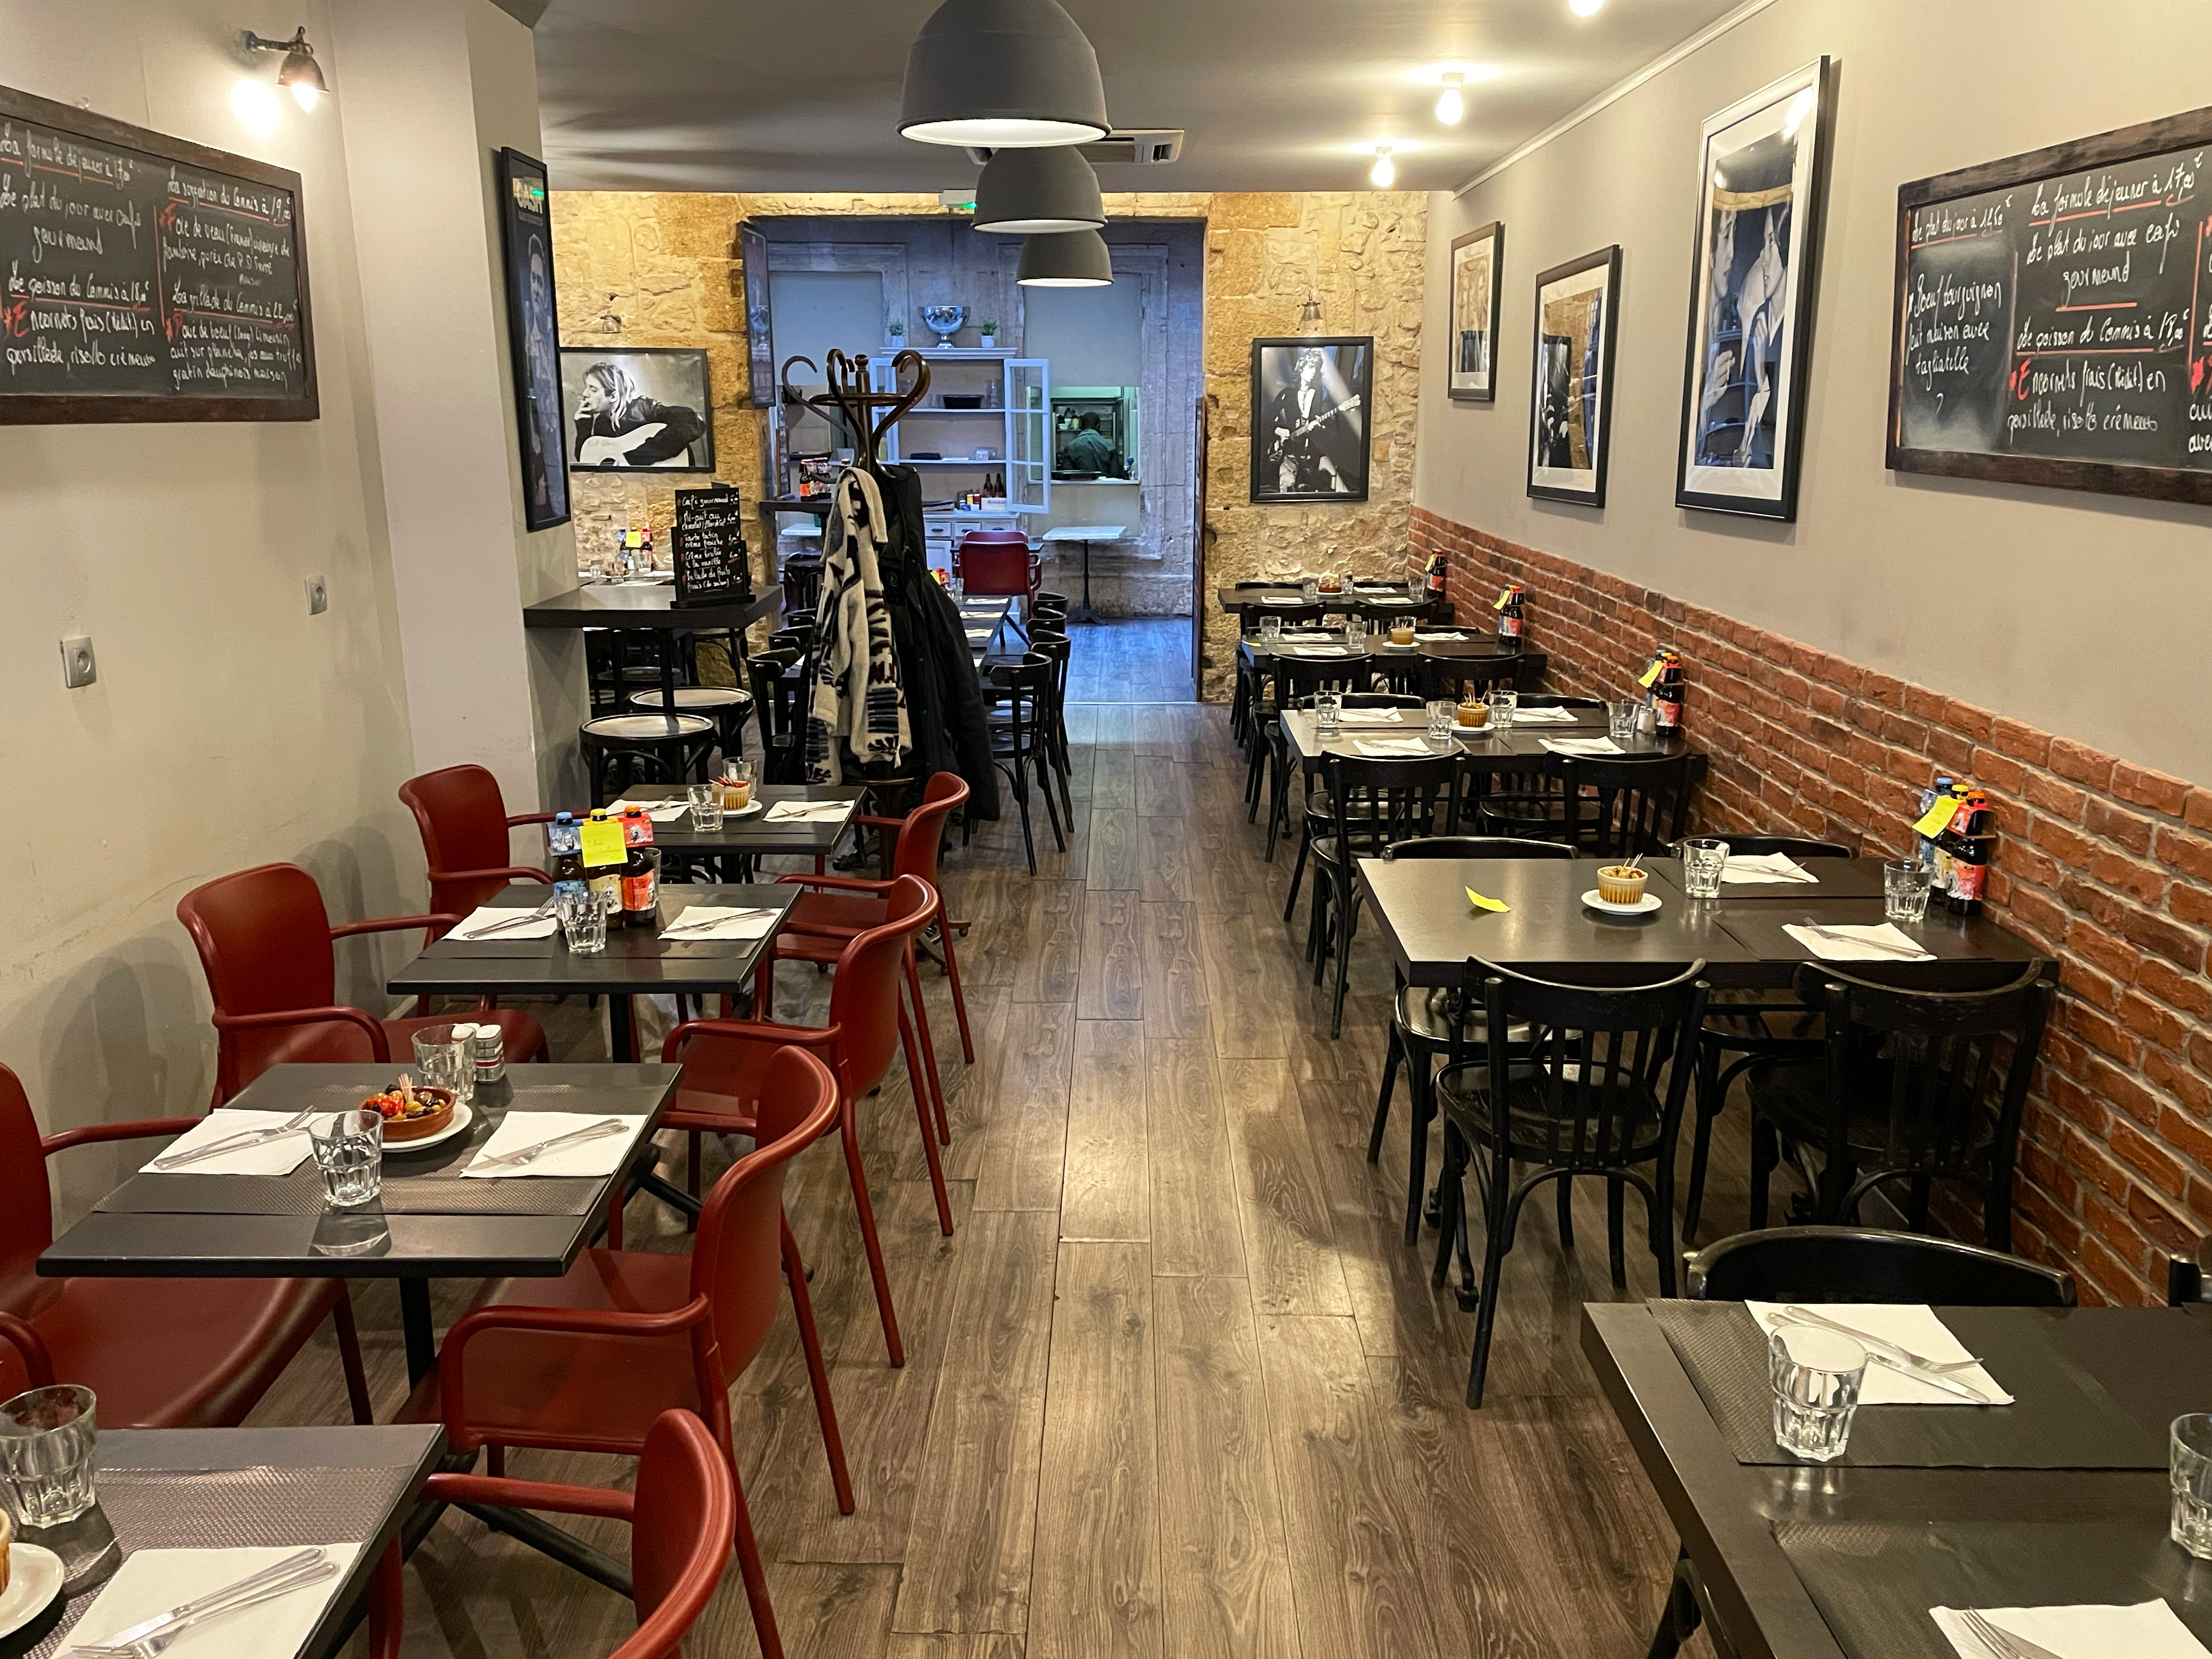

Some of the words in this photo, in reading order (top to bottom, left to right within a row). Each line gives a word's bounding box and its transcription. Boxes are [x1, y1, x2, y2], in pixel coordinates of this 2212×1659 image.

[24, 129, 63, 178] formule
[21, 181, 45, 213] plat
[49, 184, 63, 210] du
[65, 195, 89, 220] jour
[93, 207, 113, 222] avec
[220, 184, 230, 205] du
[261, 198, 269, 214] à
[2031, 183, 2049, 216] La
[2048, 176, 2093, 238] formule
[2096, 175, 2149, 220] déjeuner
[2152, 174, 2161, 194] à
[32, 226, 103, 264] gourmand
[193, 215, 202, 238] de
[280, 238, 290, 257] de
[1925, 210, 1940, 248] plat
[1942, 208, 1952, 233] du
[1952, 212, 1969, 243] jour
[1970, 208, 1977, 229] à
[2026, 232, 2042, 265] Le
[2047, 226, 2070, 264] plat
[2073, 228, 2087, 254] du
[2088, 229, 2110, 252] jour
[2114, 228, 2137, 248] avec
[2146, 212, 2180, 275] café
[8, 259, 25, 293] Le
[28, 276, 66, 302] poisson
[69, 274, 81, 297] du
[87, 273, 119, 300] Commis
[172, 278, 187, 304] La
[189, 284, 221, 313] grillade
[223, 290, 233, 311] du
[2062, 250, 2130, 309] gourmand
[1914, 273, 1944, 329] Boeuf
[1943, 274, 2001, 321] bourguignon
[80, 307, 105, 343] frais
[140, 319, 155, 336] en
[199, 319, 208, 338] de
[1927, 322, 1959, 343] maison
[1963, 321, 1990, 341] avec
[2017, 316, 2032, 350] Le
[2036, 326, 2074, 355] poisson
[2079, 315, 2094, 345] du
[2100, 317, 2140, 342] Commis
[2143, 315, 2154, 339] à
[190, 346, 204, 357] sur
[172, 362, 203, 391] gratin
[2080, 360, 2106, 407] frais
[2146, 370, 2166, 392] en
[2063, 401, 2097, 432] risotto
[700, 493, 728, 507] gourmand
